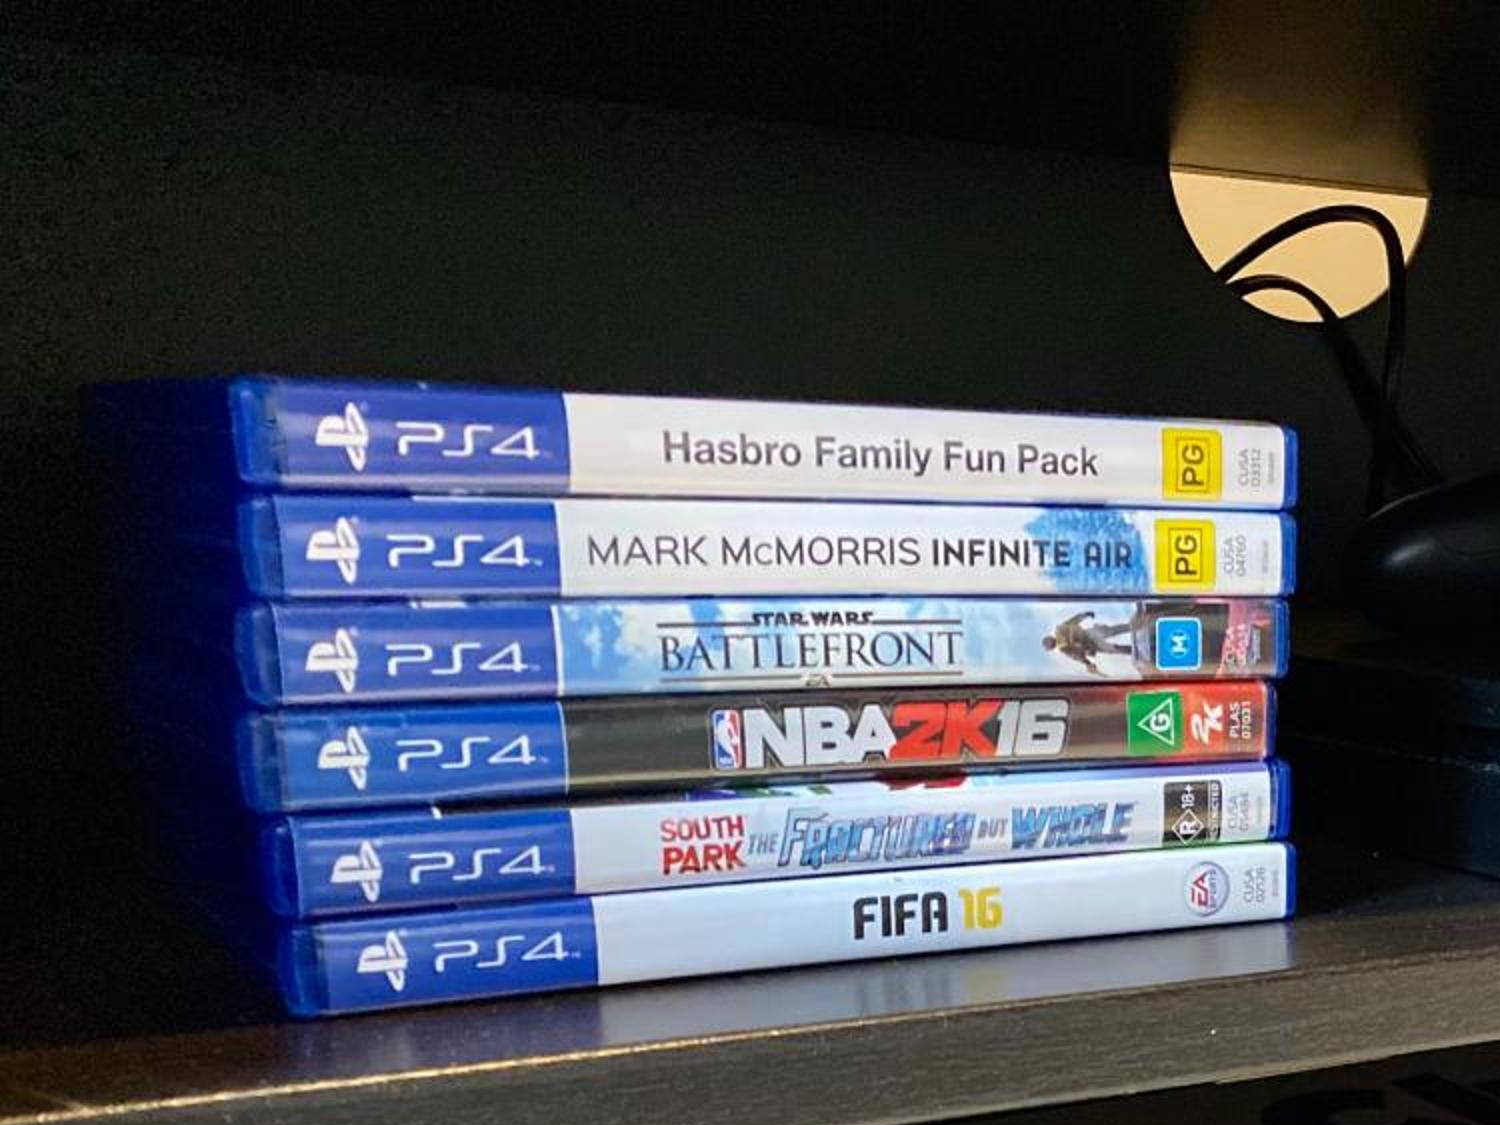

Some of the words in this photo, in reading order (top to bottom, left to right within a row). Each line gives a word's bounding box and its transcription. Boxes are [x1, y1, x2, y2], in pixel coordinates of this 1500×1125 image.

[396, 420, 541, 460] PS4
[662, 430, 800, 466] Hasbro
[815, 436, 932, 477] Family
[943, 441, 1006, 474] Fun
[1017, 443, 1100, 477] Pack
[1181, 444, 1205, 487] PG
[386, 534, 532, 567] PS4
[588, 536, 708, 566] MARK
[720, 536, 921, 567] McMORRIS
[932, 538, 1072, 568] INFINITE
[1083, 541, 1135, 569] AIR
[1173, 534, 1198, 576] PG
[752, 612, 811, 627] STAR
[812, 611, 874, 626] WARS
[386, 643, 530, 676] PS4
[658, 631, 964, 672] BATTLEFRONT
[1150, 710, 1172, 731] G
[1191, 702, 1224, 744] 2K
[397, 735, 540, 772] PS4
[661, 815, 744, 843] SOUTH
[748, 833, 779, 855] THE
[977, 818, 1009, 839] BUT
[1011, 801, 1138, 850] WHOLE
[409, 846, 547, 884] PS4
[661, 841, 747, 876] PARK
[1190, 870, 1211, 908] EA
[853, 891, 949, 940] FIFA
[958, 886, 1003, 931] 16
[432, 932, 570, 973] PS4
